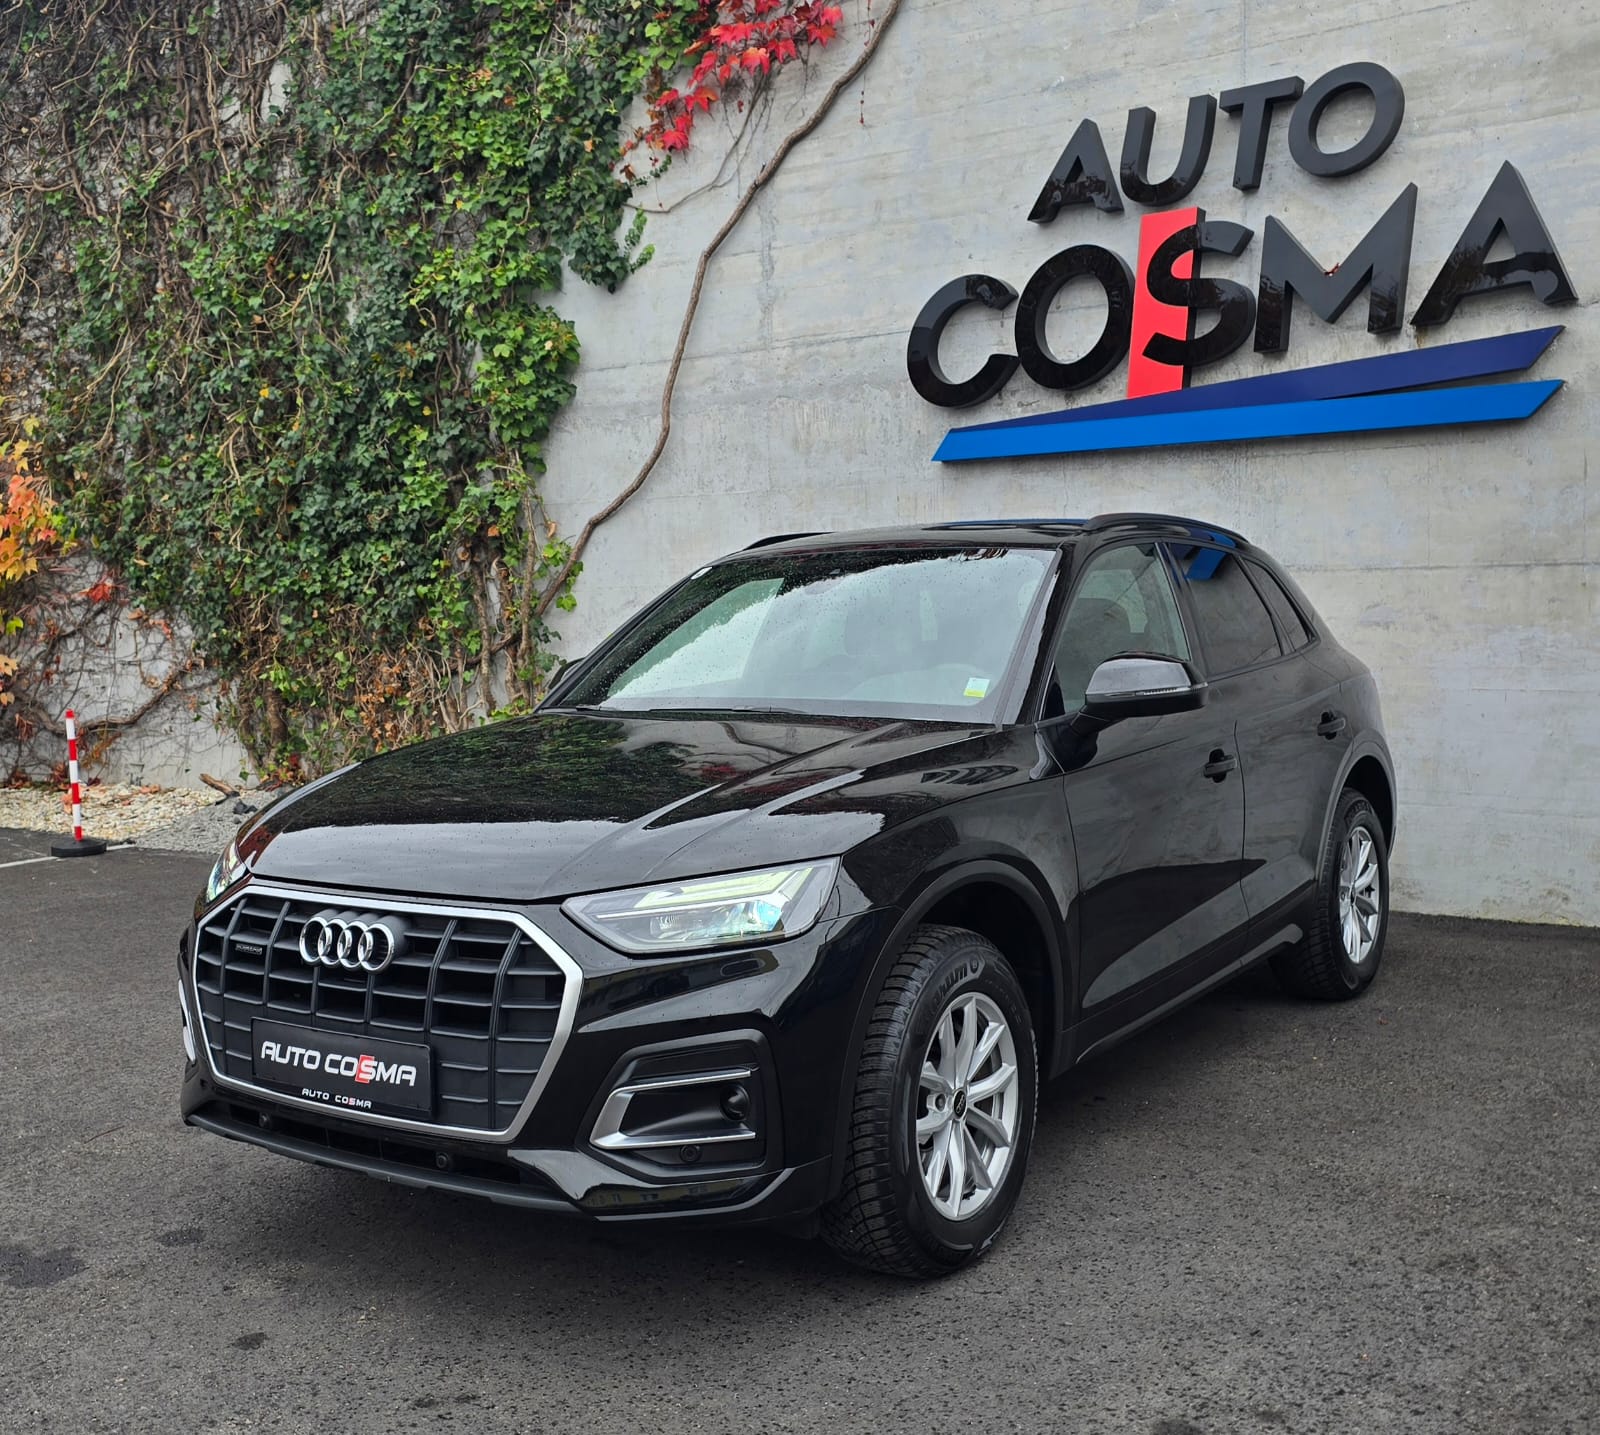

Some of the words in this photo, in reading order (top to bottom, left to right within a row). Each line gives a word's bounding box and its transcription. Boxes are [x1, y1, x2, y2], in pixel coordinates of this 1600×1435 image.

[1027, 61, 1405, 222] AUTO
[907, 160, 1579, 408] COSMA
[261, 1040, 321, 1070] AUTO
[324, 1053, 417, 1087] COSMA
[302, 1088, 330, 1101] AUTO
[334, 1095, 372, 1109] COSMA
